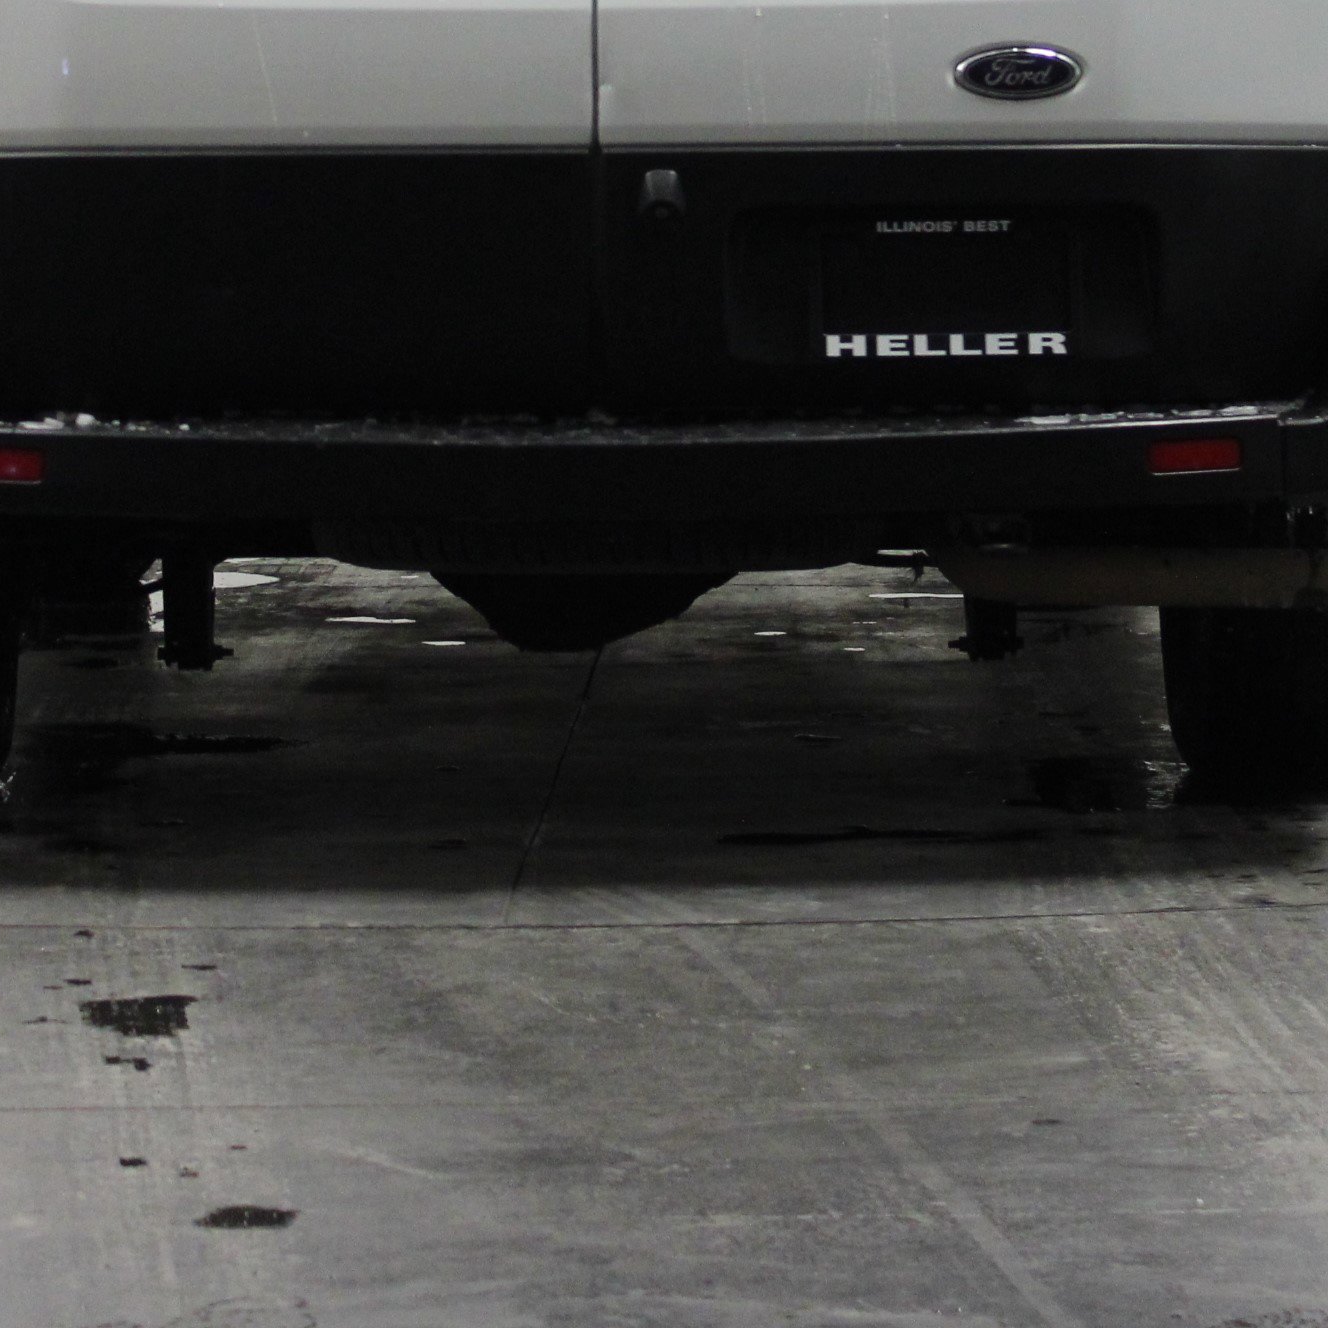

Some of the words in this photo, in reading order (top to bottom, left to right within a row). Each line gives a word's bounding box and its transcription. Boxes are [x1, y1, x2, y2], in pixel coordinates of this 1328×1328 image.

[984, 58, 1052, 86] Ford
[963, 220, 1011, 232] BEST
[825, 332, 1068, 358] HELLER
